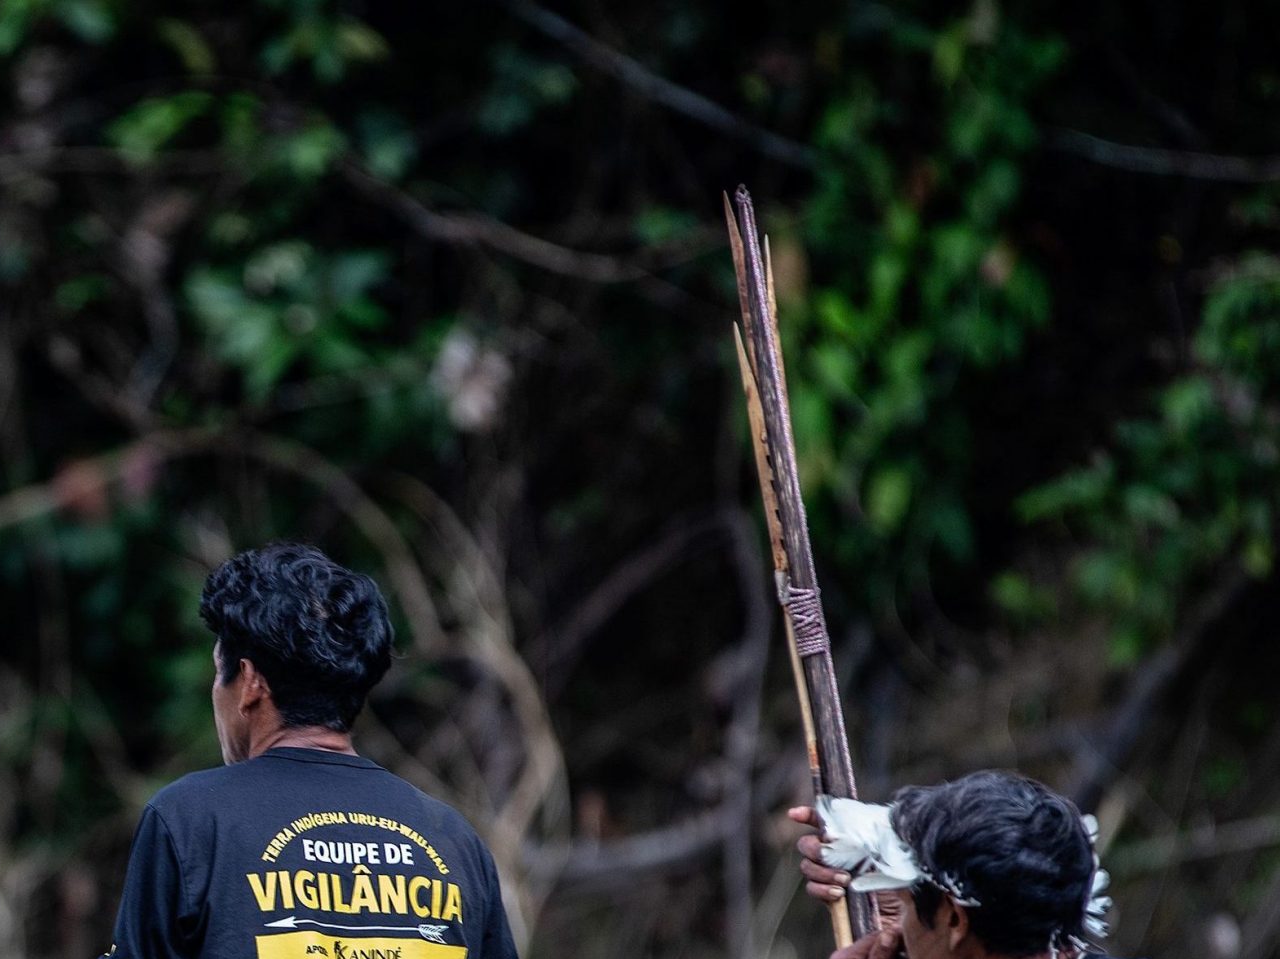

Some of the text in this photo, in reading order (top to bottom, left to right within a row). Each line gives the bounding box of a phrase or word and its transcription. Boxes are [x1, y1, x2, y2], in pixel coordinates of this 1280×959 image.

[261, 826, 297, 863] TERRA
[291, 812, 349, 835] INDÍGENA
[302, 839, 414, 866] EQUIPE DE
[246, 864, 464, 925] VIGILÂNCIA
